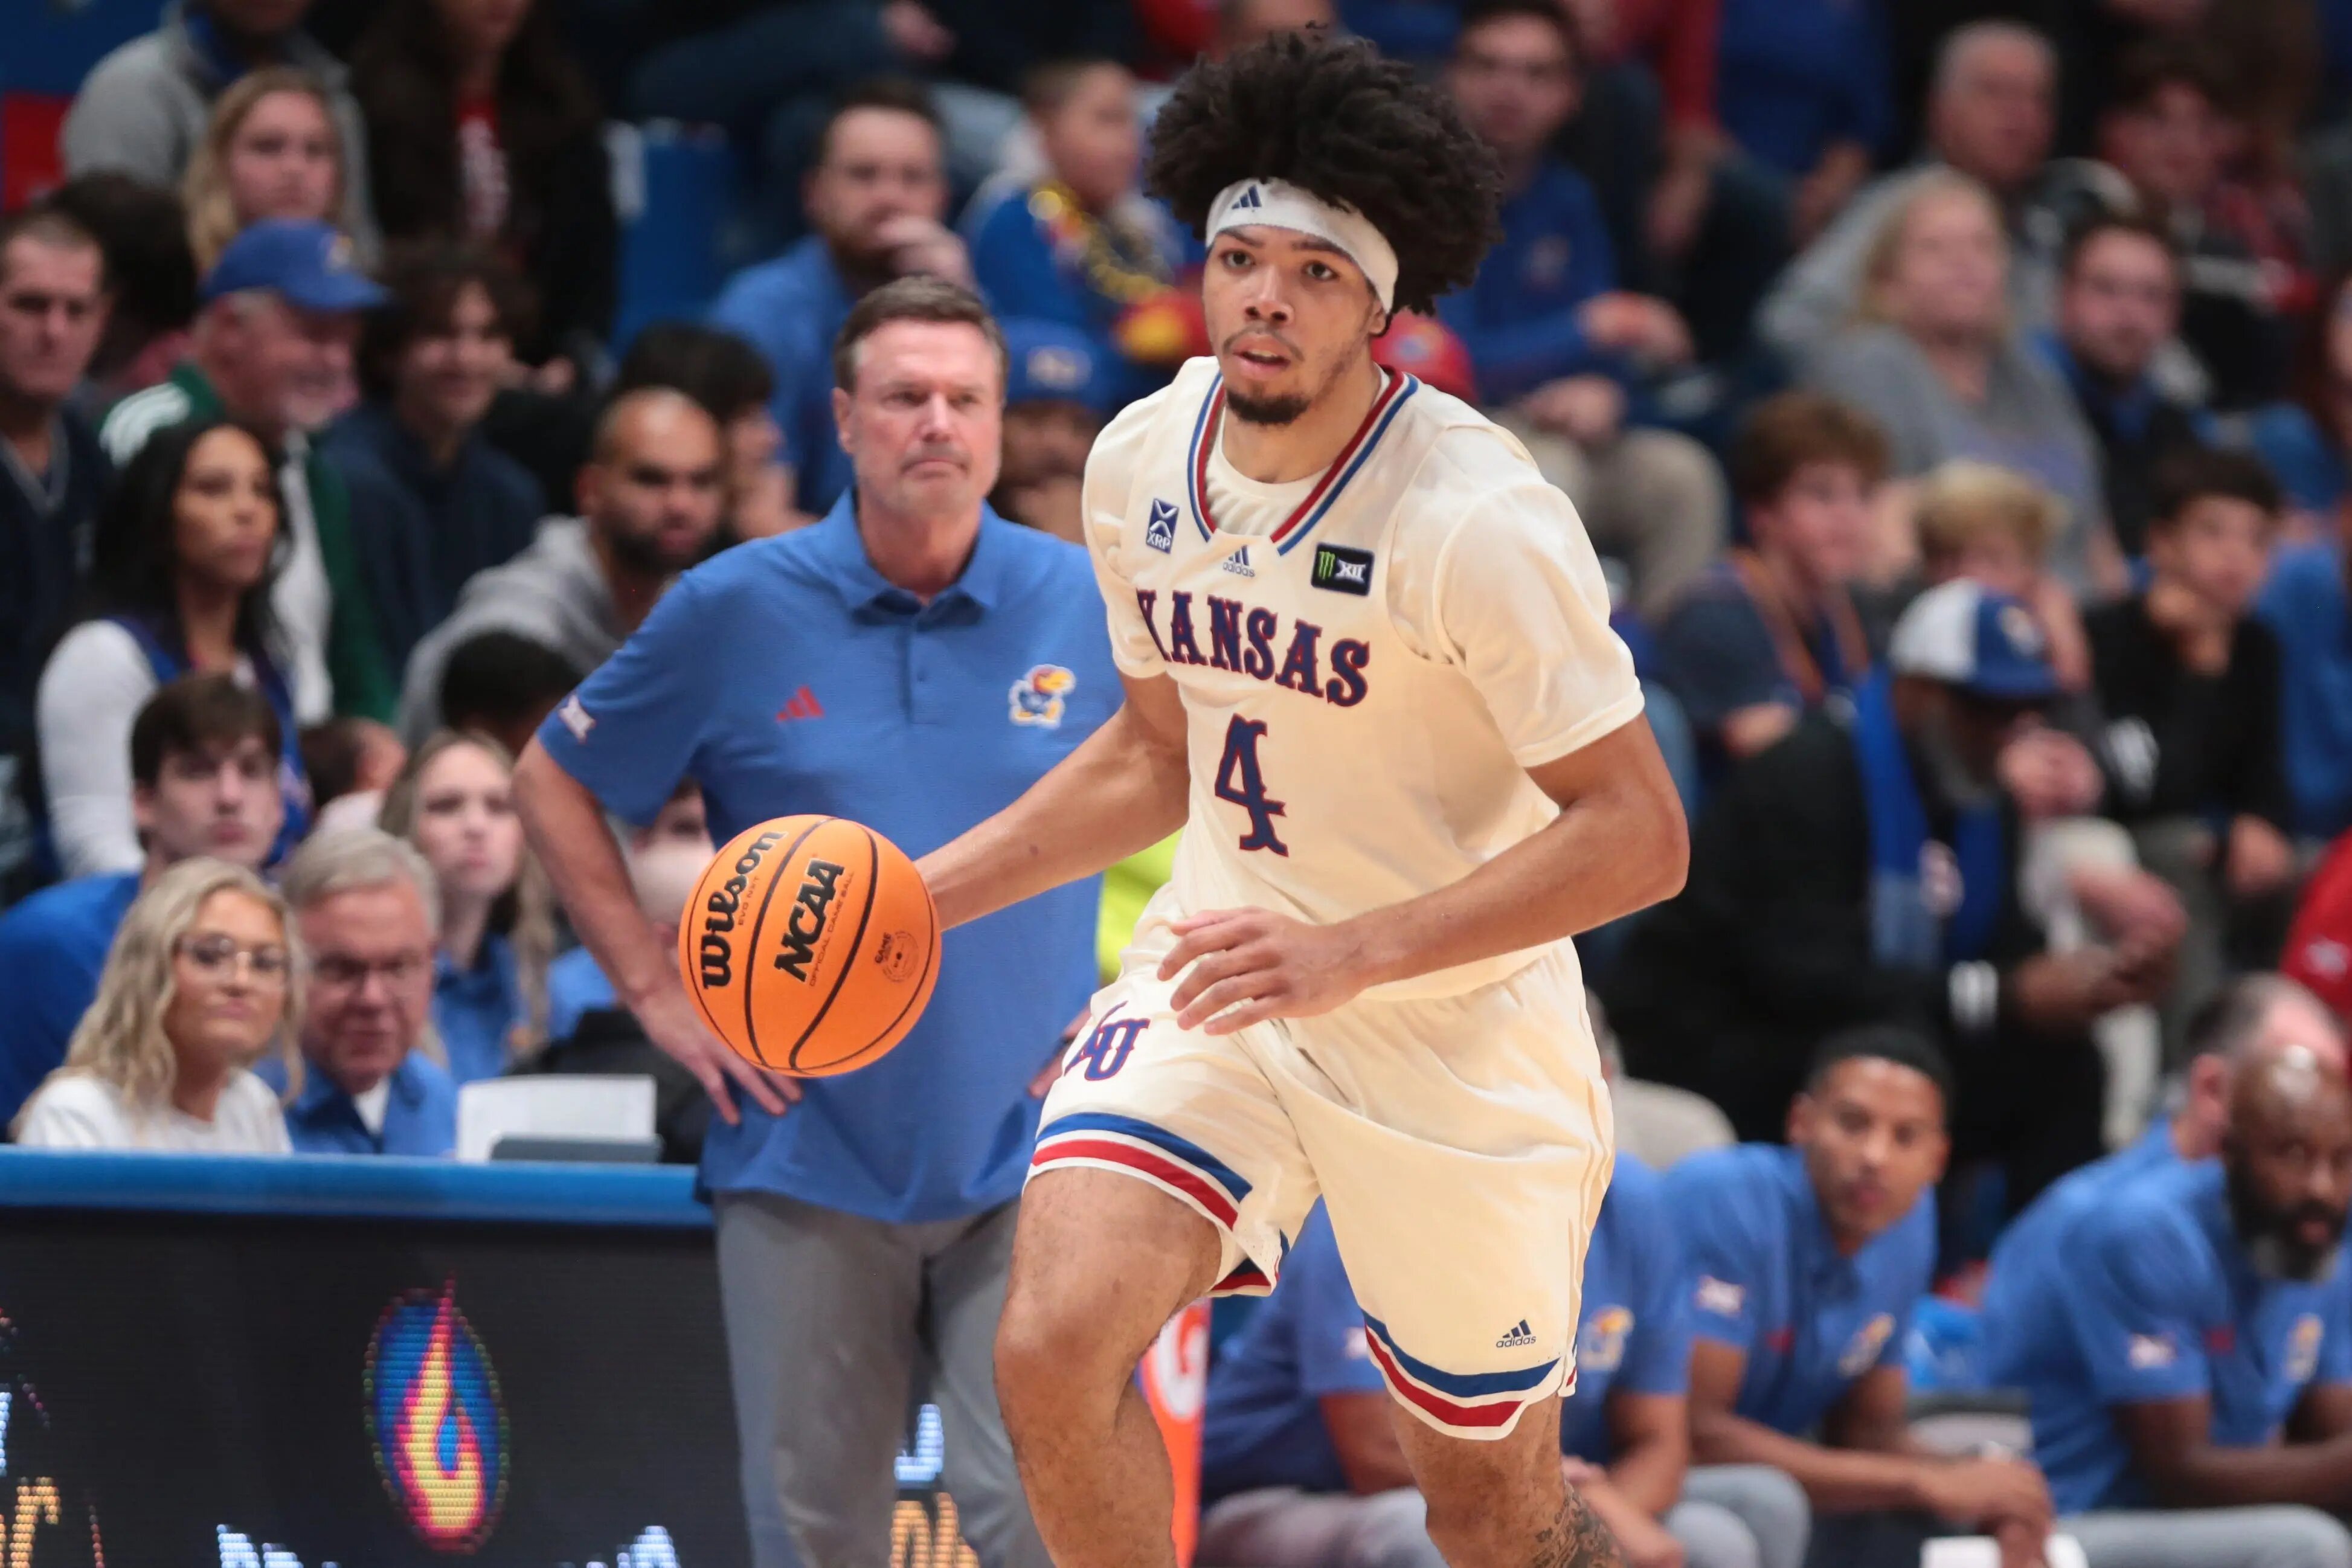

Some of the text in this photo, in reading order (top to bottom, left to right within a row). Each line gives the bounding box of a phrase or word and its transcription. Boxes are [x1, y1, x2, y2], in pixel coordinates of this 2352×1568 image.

[1147, 530, 1171, 550] XRP
[1223, 561, 1255, 577] adidas
[1214, 713, 1289, 858] 4
[701, 831, 788, 989] Wilson
[738, 901, 751, 925] EVO
[773, 858, 844, 983] NCAA
[809, 871, 855, 986] OFFICIAL GAME BALL
[1496, 1334, 1537, 1348] adidas
